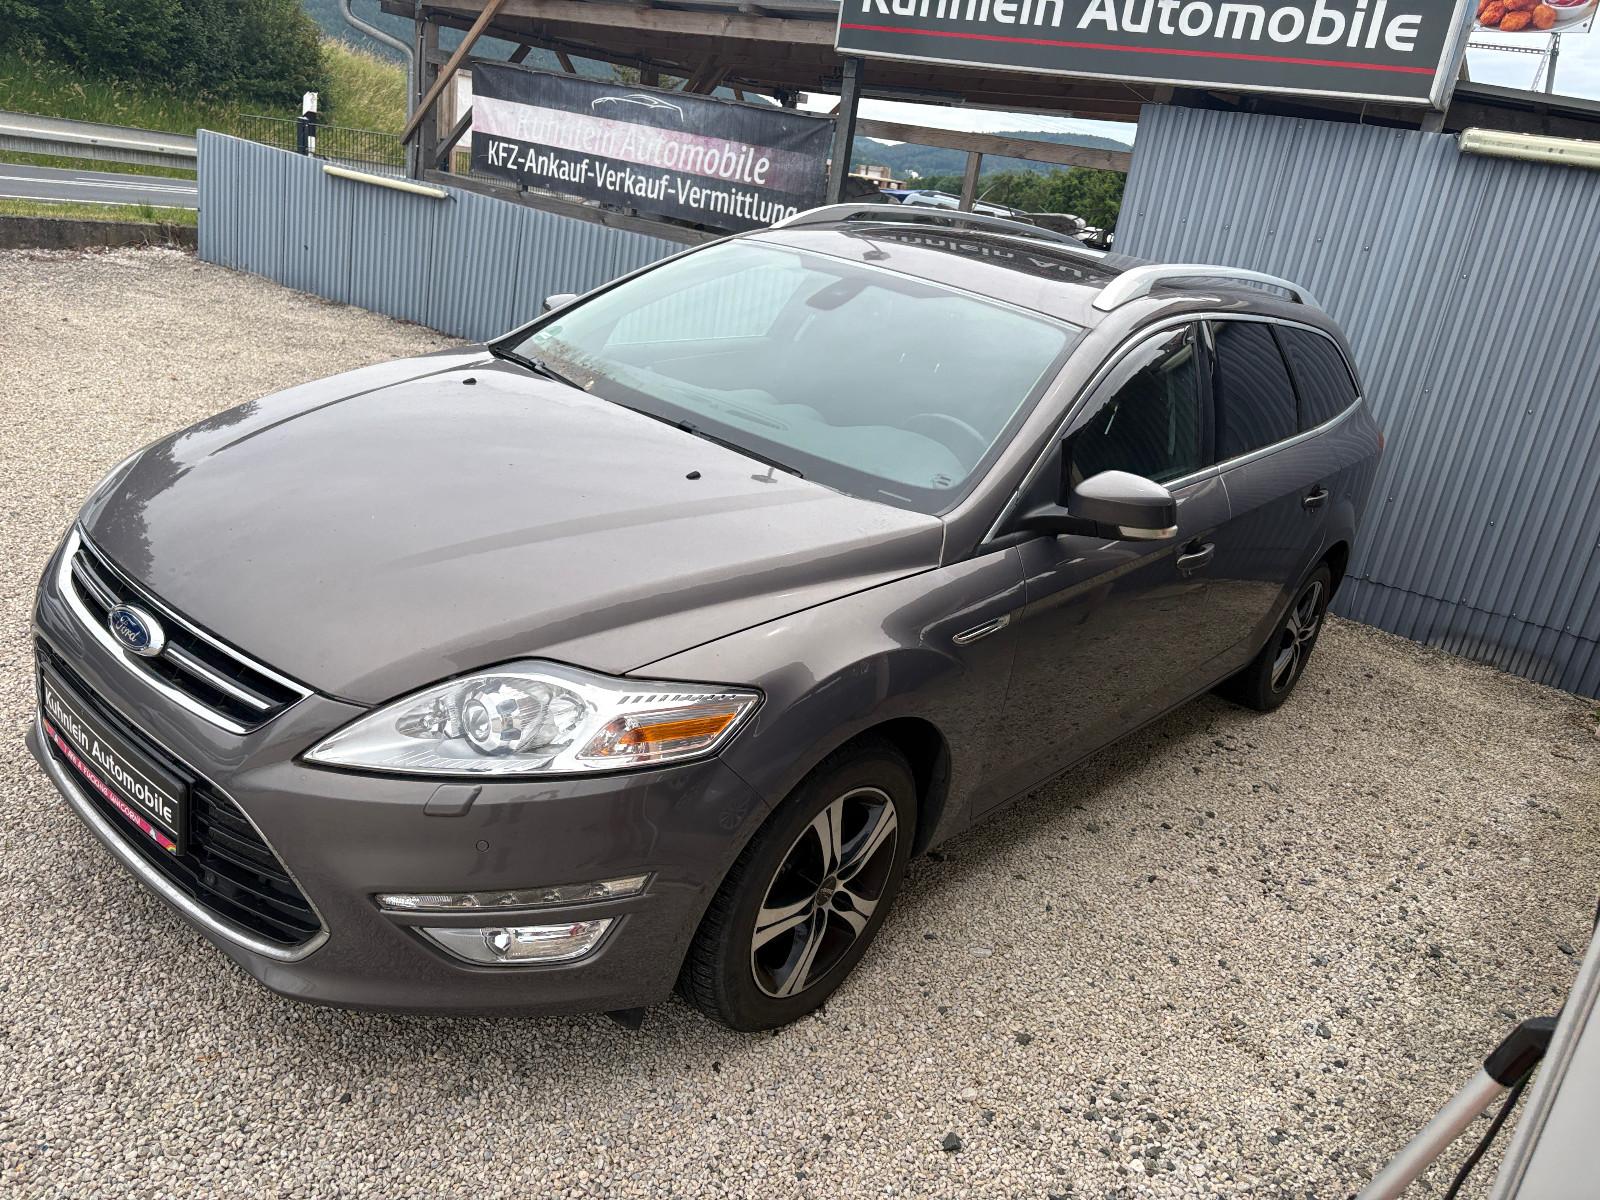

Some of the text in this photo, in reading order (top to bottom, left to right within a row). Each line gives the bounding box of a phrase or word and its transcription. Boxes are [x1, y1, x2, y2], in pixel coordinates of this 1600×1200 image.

[1076, 0, 1422, 51] Automobile
[620, 127, 770, 184] Automobile
[114, 615, 141, 642] Ford
[46, 687, 172, 823] Kuhnlein Automobile
[110, 791, 141, 825] UNICORN
